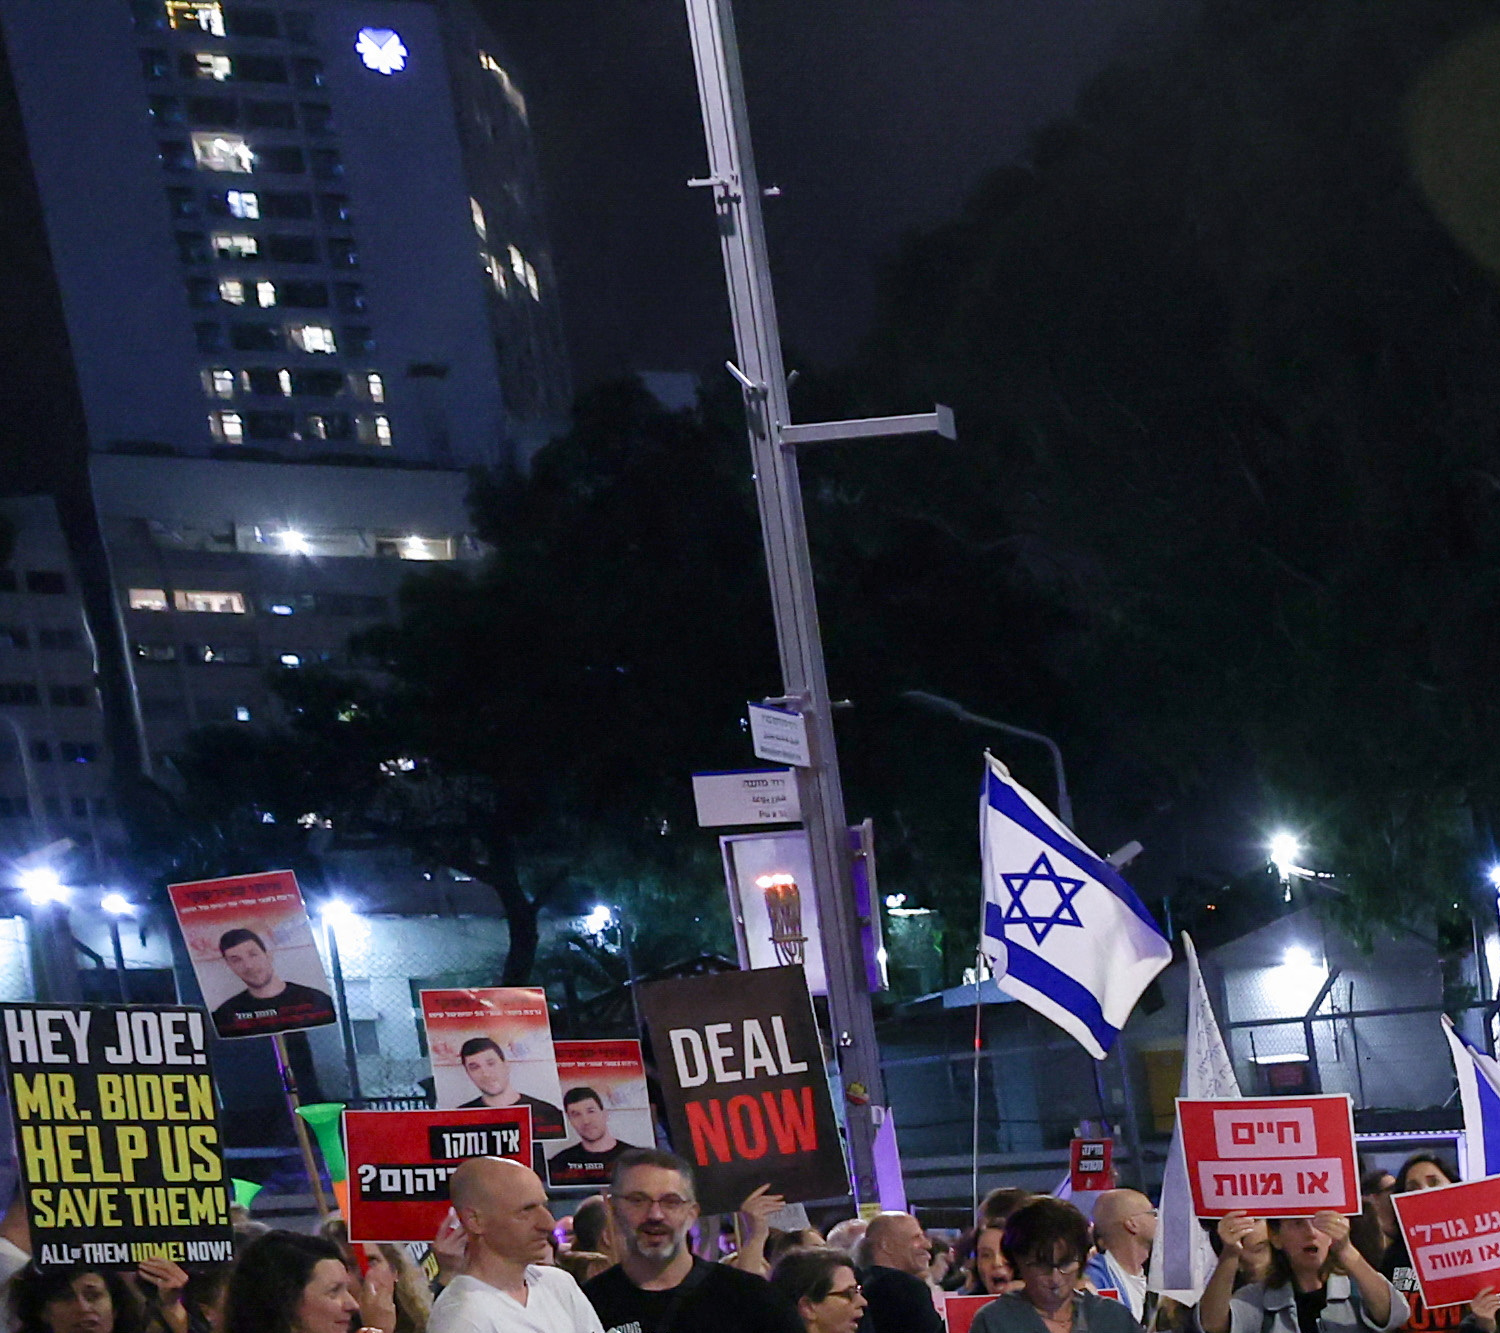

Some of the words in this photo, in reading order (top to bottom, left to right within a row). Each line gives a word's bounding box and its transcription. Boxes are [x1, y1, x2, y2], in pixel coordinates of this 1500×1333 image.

[4, 1009, 91, 1064] HEY
[105, 1010, 207, 1065] JOE!
[668, 1016, 809, 1089] DEAL
[13, 1073, 92, 1120] MR.
[97, 1074, 214, 1121] BIDEN
[685, 1087, 819, 1166] NOW
[1231, 1120, 1302, 1146] חיים
[22, 1125, 148, 1183] HELP
[157, 1125, 222, 1182] US
[491, 1129, 521, 1156] איך
[1213, 1172, 1284, 1197] מוות
[1296, 1171, 1330, 1195] או
[31, 1188, 123, 1228] SAVE
[125, 1187, 228, 1227] THEM!
[1409, 1217, 1467, 1243] גורלי
[41, 1244, 75, 1265] ALL
[82, 1243, 129, 1264] THEM
[188, 1241, 233, 1263] NOW!
[1428, 1250, 1474, 1271] מוות
[1478, 1243, 1500, 1260] או
